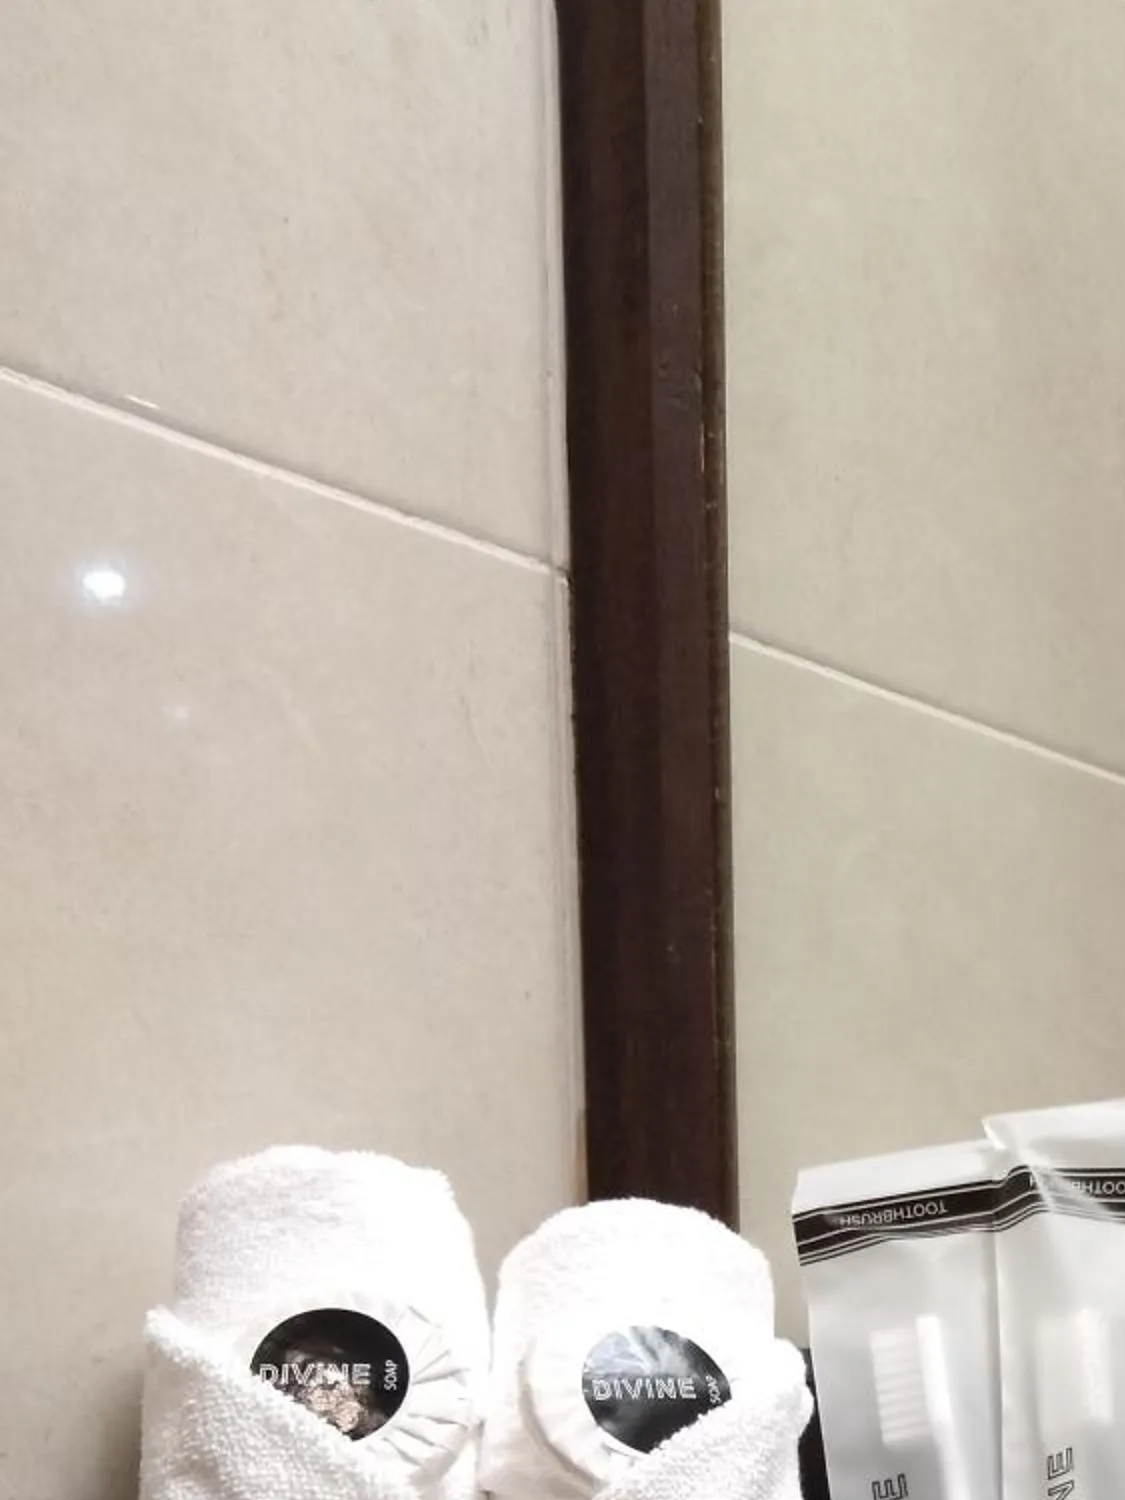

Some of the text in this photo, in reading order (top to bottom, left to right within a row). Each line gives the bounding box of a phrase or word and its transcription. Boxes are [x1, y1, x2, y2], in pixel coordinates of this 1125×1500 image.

[839, 1199, 948, 1227] TOOTHBRUSH
[259, 1363, 372, 1386] DIVINE
[384, 1359, 400, 1391] SOAP
[591, 1376, 698, 1401] DIVINE
